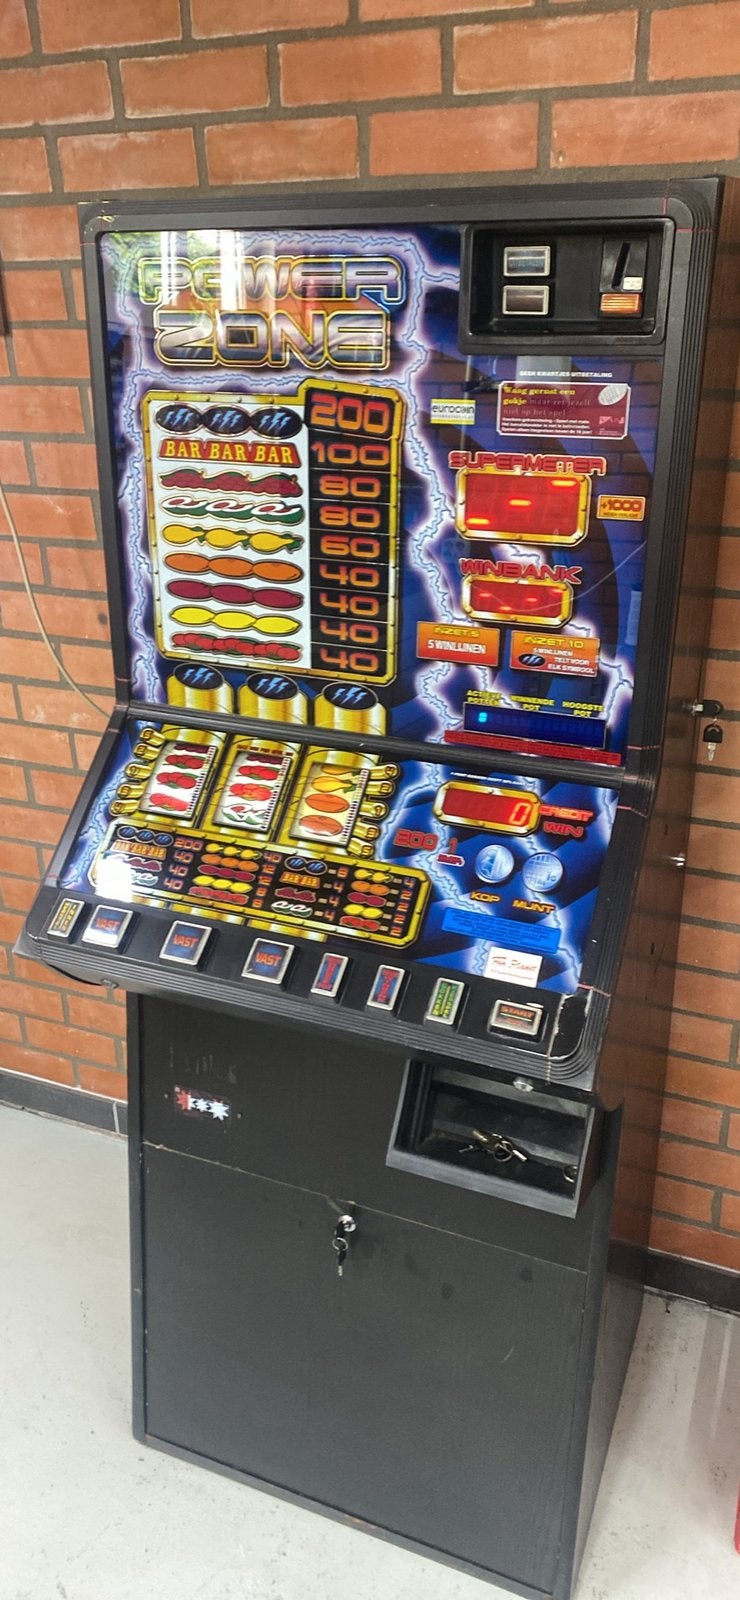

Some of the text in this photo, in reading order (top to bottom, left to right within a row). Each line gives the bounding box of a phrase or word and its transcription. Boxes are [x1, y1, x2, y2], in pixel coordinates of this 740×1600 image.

[138, 255, 406, 304] POWER
[154, 309, 390, 370] ZONE
[503, 386, 528, 396] Waag
[528, 388, 557, 396] gerust
[503, 397, 527, 406] gokje
[310, 393, 389, 434] 200
[165, 440, 294, 463] BAR BAR BAR
[310, 442, 389, 466] 100
[449, 451, 607, 476] SUPERMETER
[319, 474, 381, 497] 80
[319, 505, 381, 528] 80
[600, 499, 643, 512] +1000
[320, 535, 380, 558] 60
[319, 564, 380, 588] 40
[459, 558, 583, 584] WINBANK
[319, 592, 380, 616] 40
[319, 620, 380, 644] 40
[525, 636, 584, 648] INZET 10
[427, 639, 435, 648] 5
[319, 647, 380, 672] 40
[561, 664, 595, 674] SYMBOOL
[523, 703, 541, 711] POT
[573, 709, 592, 717] POT
[562, 701, 604, 712] HOOGSTE
[508, 802, 532, 825] 0
[539, 803, 594, 822] CREDIT
[394, 829, 439, 851] 200
[543, 822, 584, 837] WIN
[173, 849, 194, 864] 40
[173, 837, 204, 851] 200
[263, 851, 282, 864] 40
[403, 876, 415, 889] 4
[168, 863, 410, 912] 40 12 4 2
[262, 864, 413, 900] 12 2
[334, 881, 345, 893] 4
[163, 877, 184, 891] 40
[324, 908, 336, 921] 4
[393, 913, 406, 924] 2
[470, 891, 500, 903] KOP
[512, 900, 556, 914] MUNT
[94, 918, 121, 930] VAST
[389, 925, 403, 937] 2
[172, 935, 198, 949] VAST
[254, 952, 281, 967] VAST
[500, 1005, 535, 1018] START
